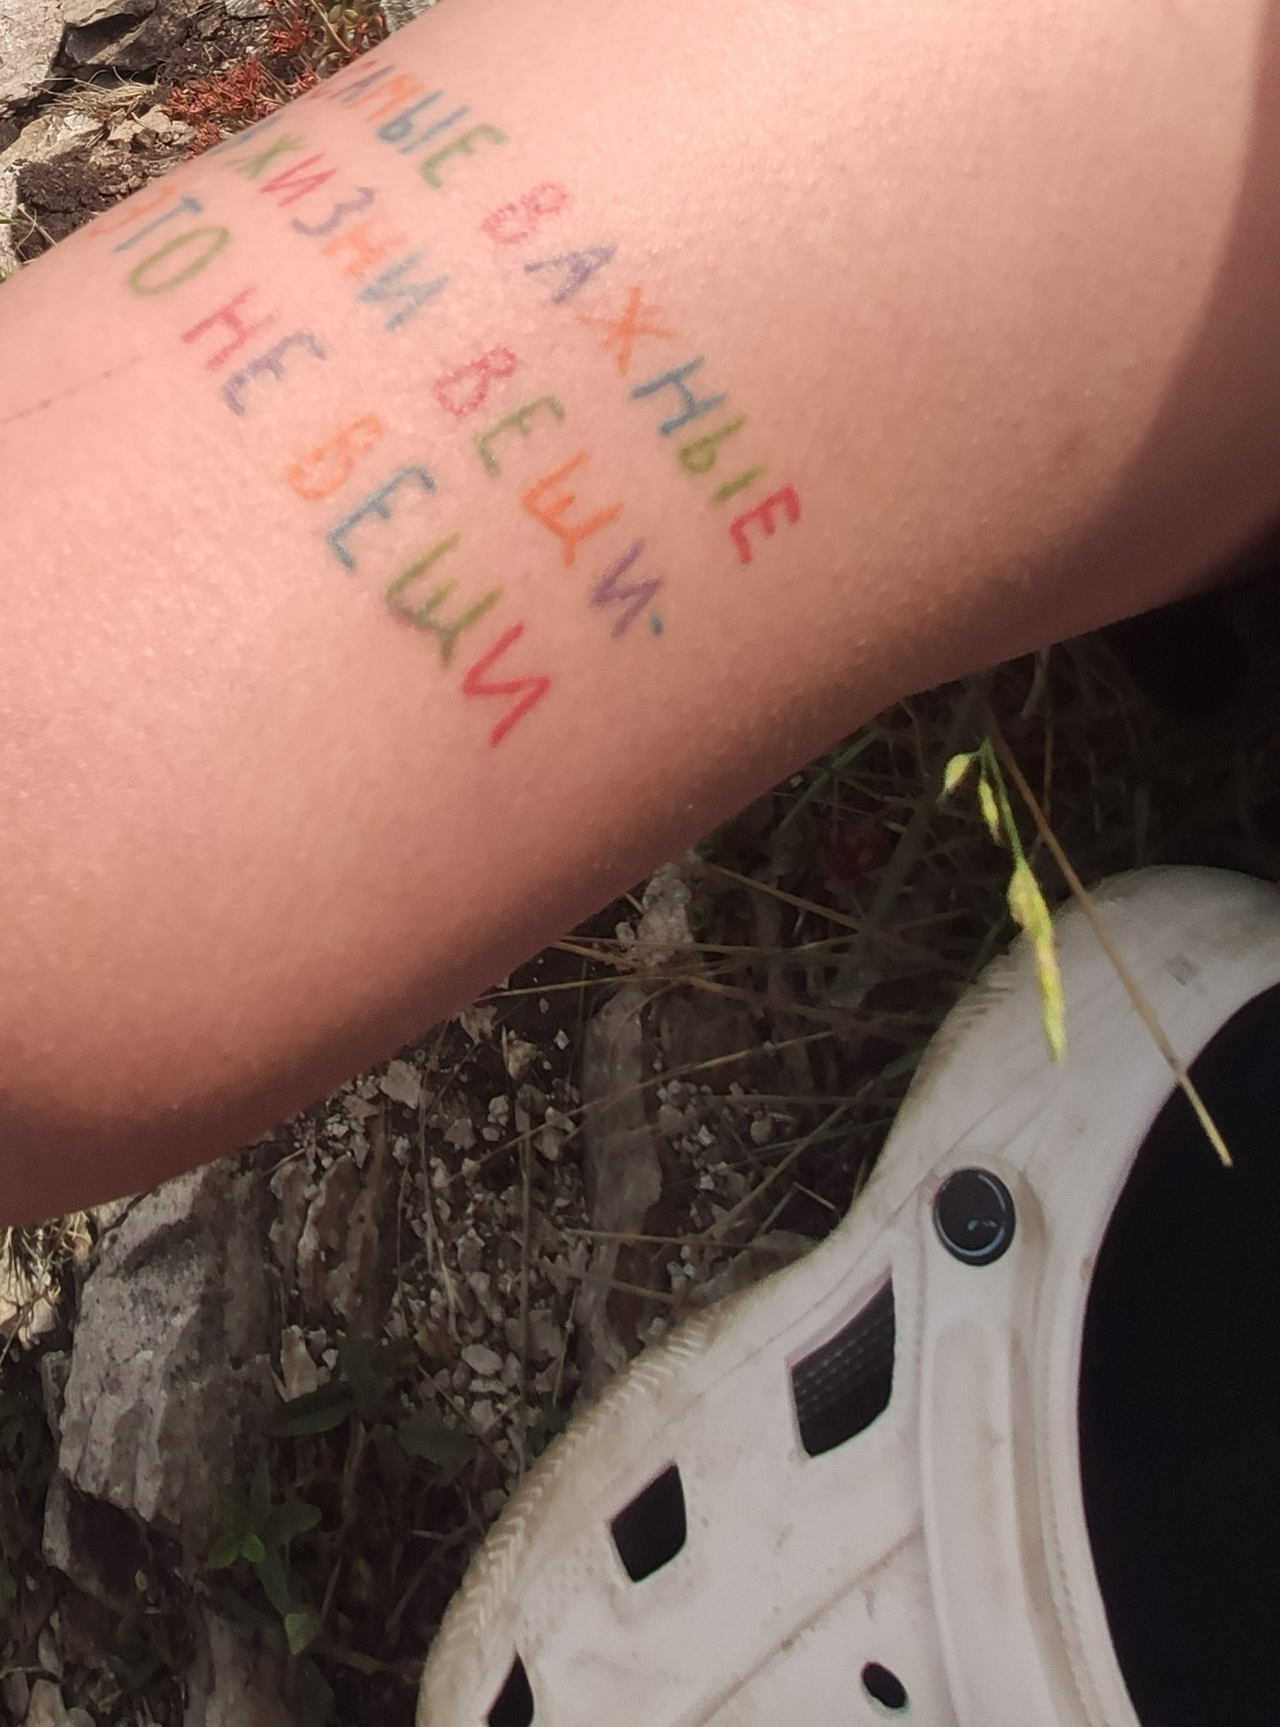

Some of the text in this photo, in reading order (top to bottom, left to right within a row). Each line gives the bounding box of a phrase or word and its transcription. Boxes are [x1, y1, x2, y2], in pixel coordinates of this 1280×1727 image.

[181, 285, 327, 416] НЕ
[284, 411, 553, 747] ВЕЩИ
[481, 180, 802, 566] ВАЖНЫЕ
